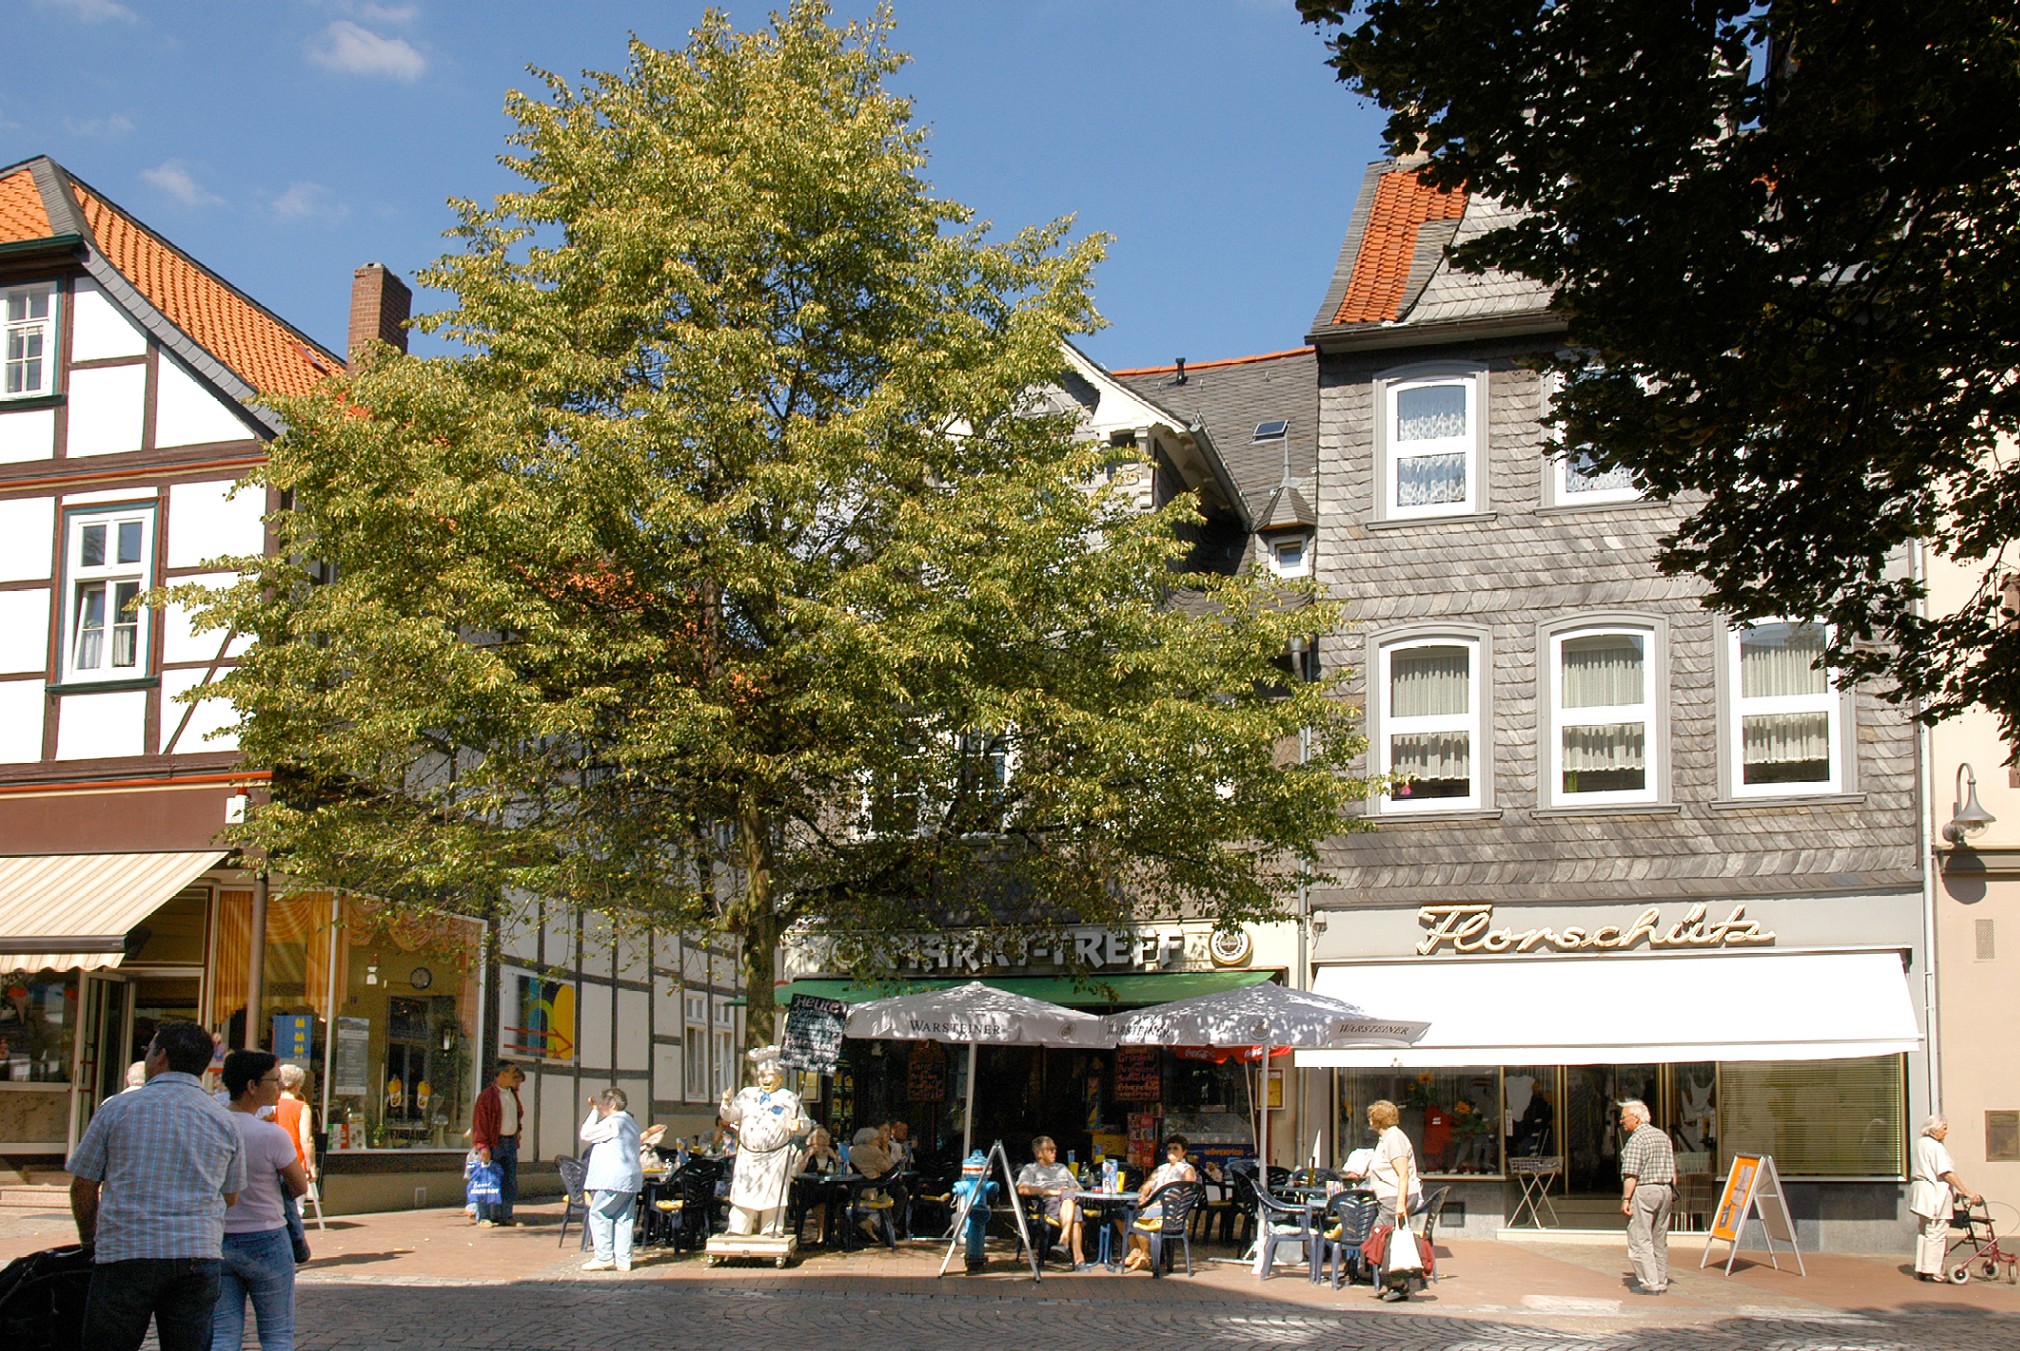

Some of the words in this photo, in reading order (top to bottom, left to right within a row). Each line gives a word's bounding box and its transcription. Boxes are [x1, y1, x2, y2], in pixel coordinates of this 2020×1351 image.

[1416, 903, 1776, 955] Florschütz
[910, 1020, 1000, 1035] WARSTEINER
[1339, 1024, 1410, 1035] WARSTEINER
